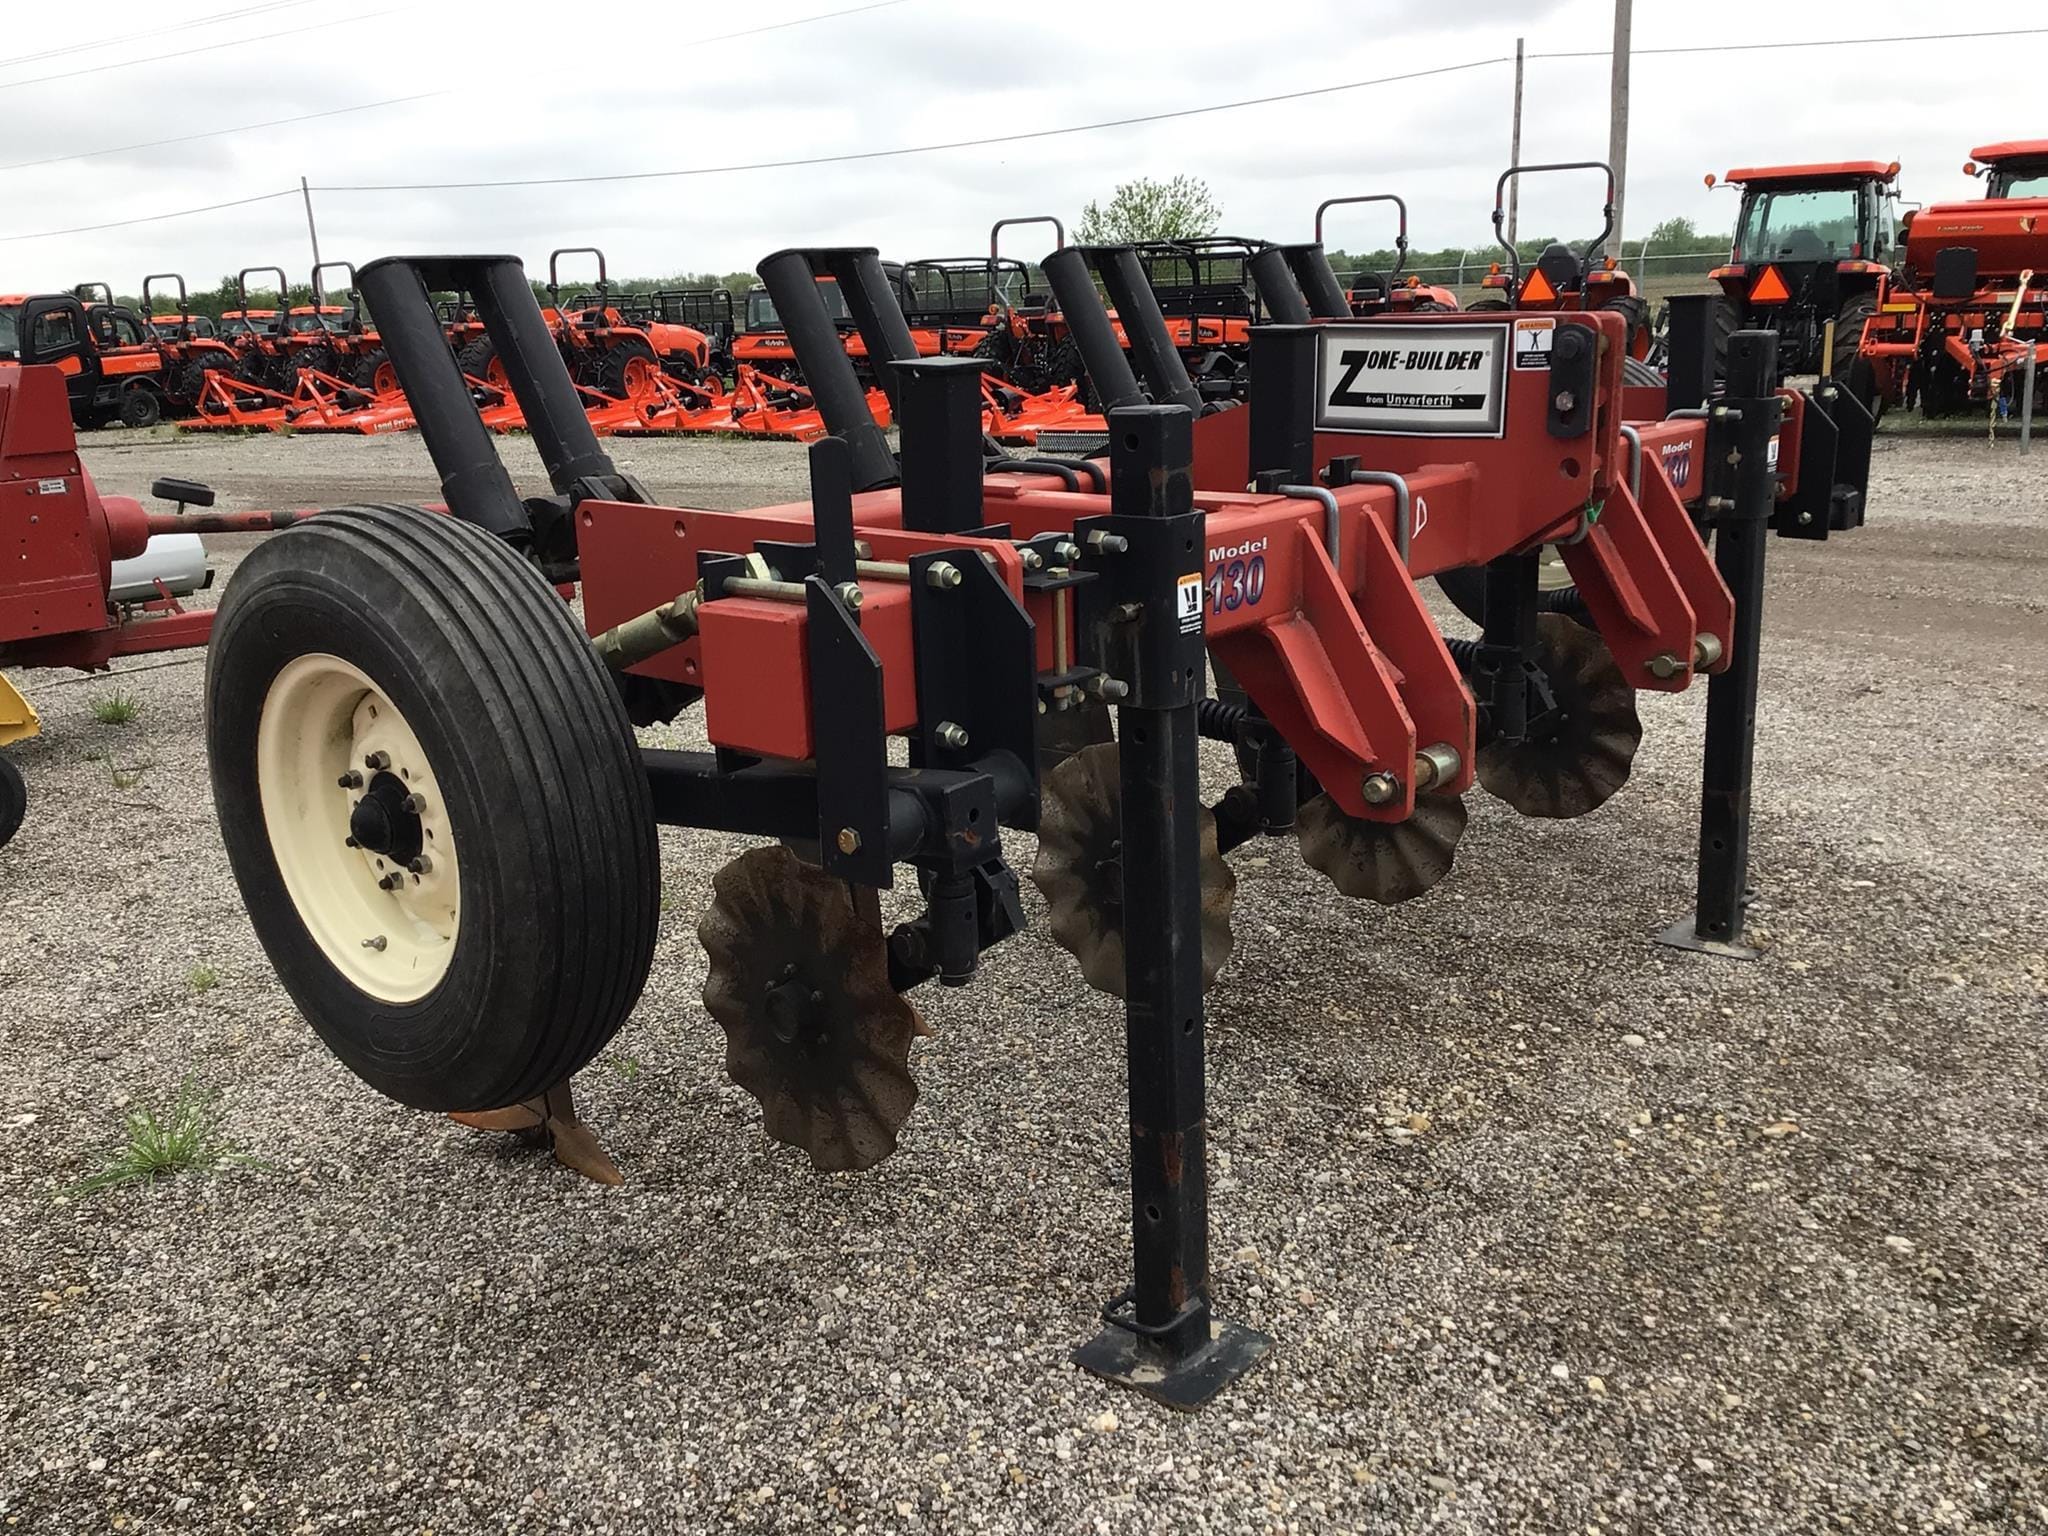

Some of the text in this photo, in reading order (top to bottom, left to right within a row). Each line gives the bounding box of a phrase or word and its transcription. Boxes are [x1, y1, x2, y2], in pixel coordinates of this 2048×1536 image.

[1366, 394, 1453, 407] from Unverferth
[1662, 440, 1692, 455] Model
[1209, 537, 1267, 562] Model
[1209, 556, 1265, 616] 130
